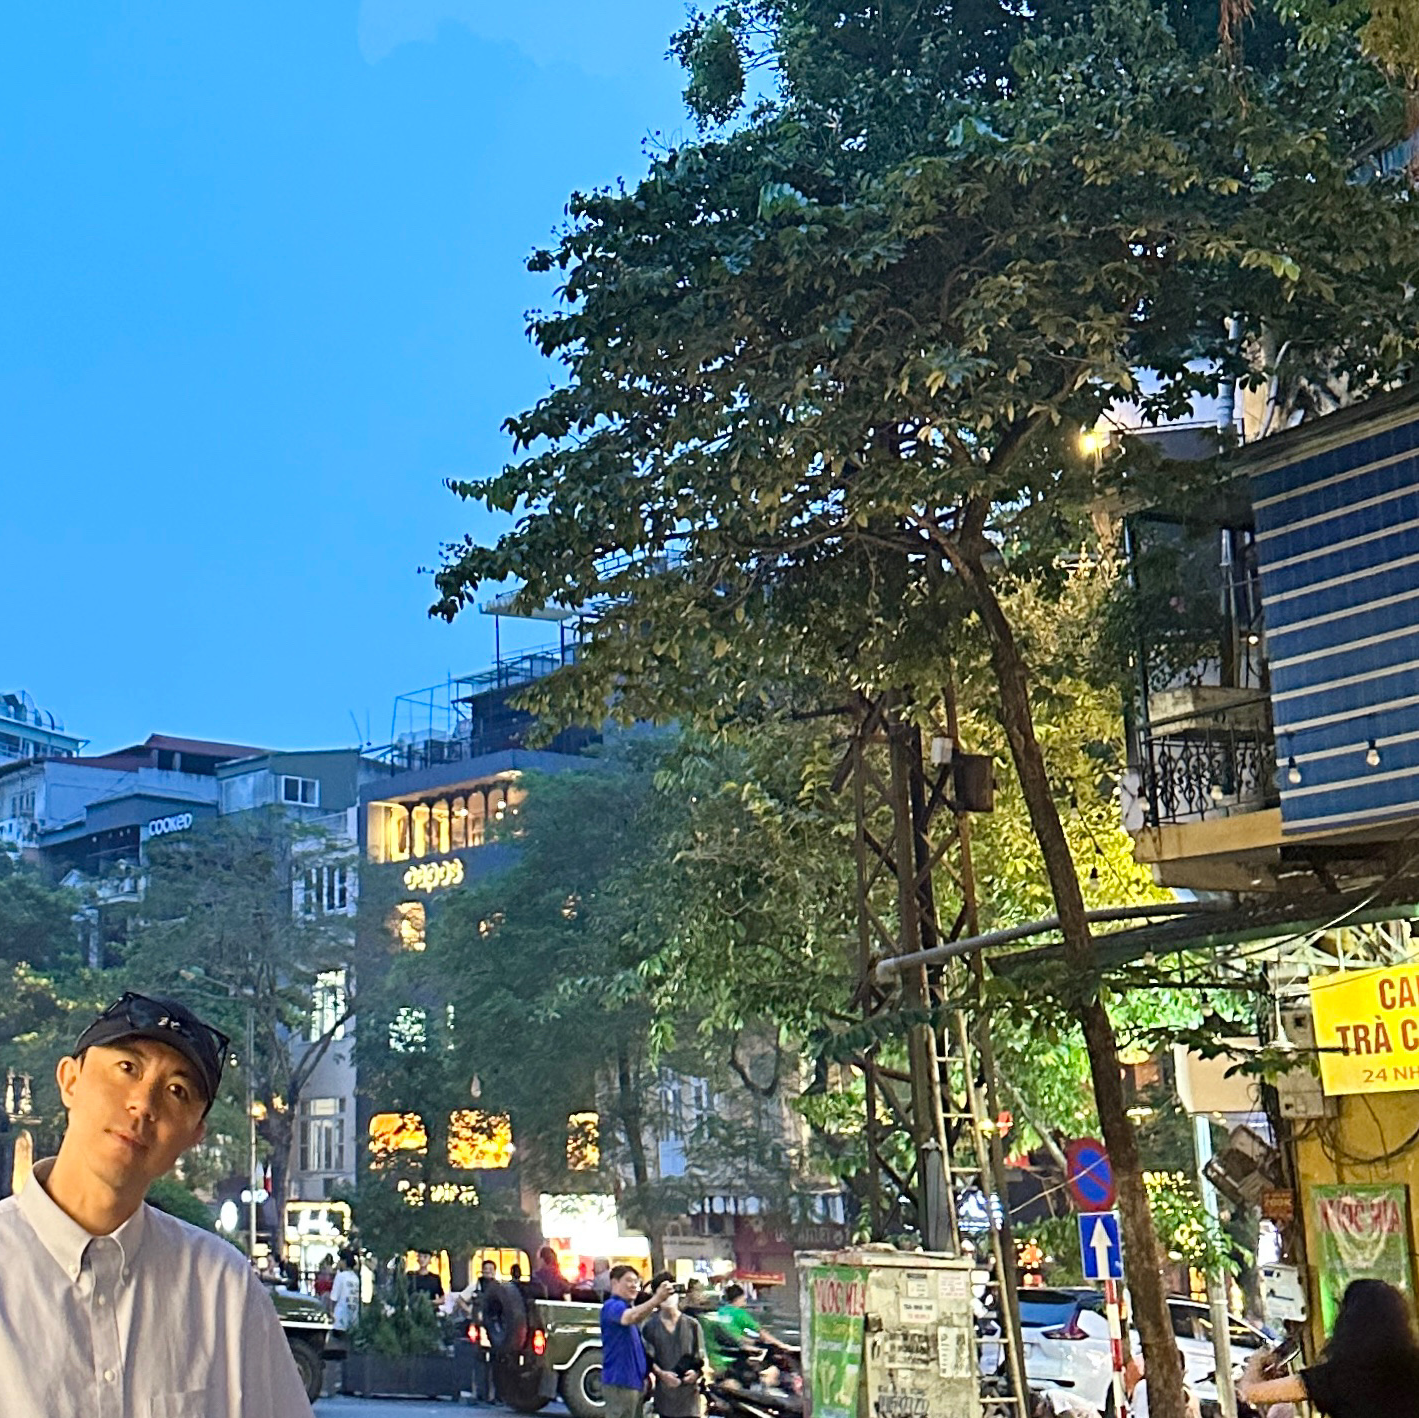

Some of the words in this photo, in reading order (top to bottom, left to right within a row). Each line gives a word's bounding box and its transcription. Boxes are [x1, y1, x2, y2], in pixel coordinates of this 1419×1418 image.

[1379, 975, 1419, 1010] CA
[1335, 1015, 1393, 1056] TRÀ
[1362, 1068, 1388, 1083] 24
